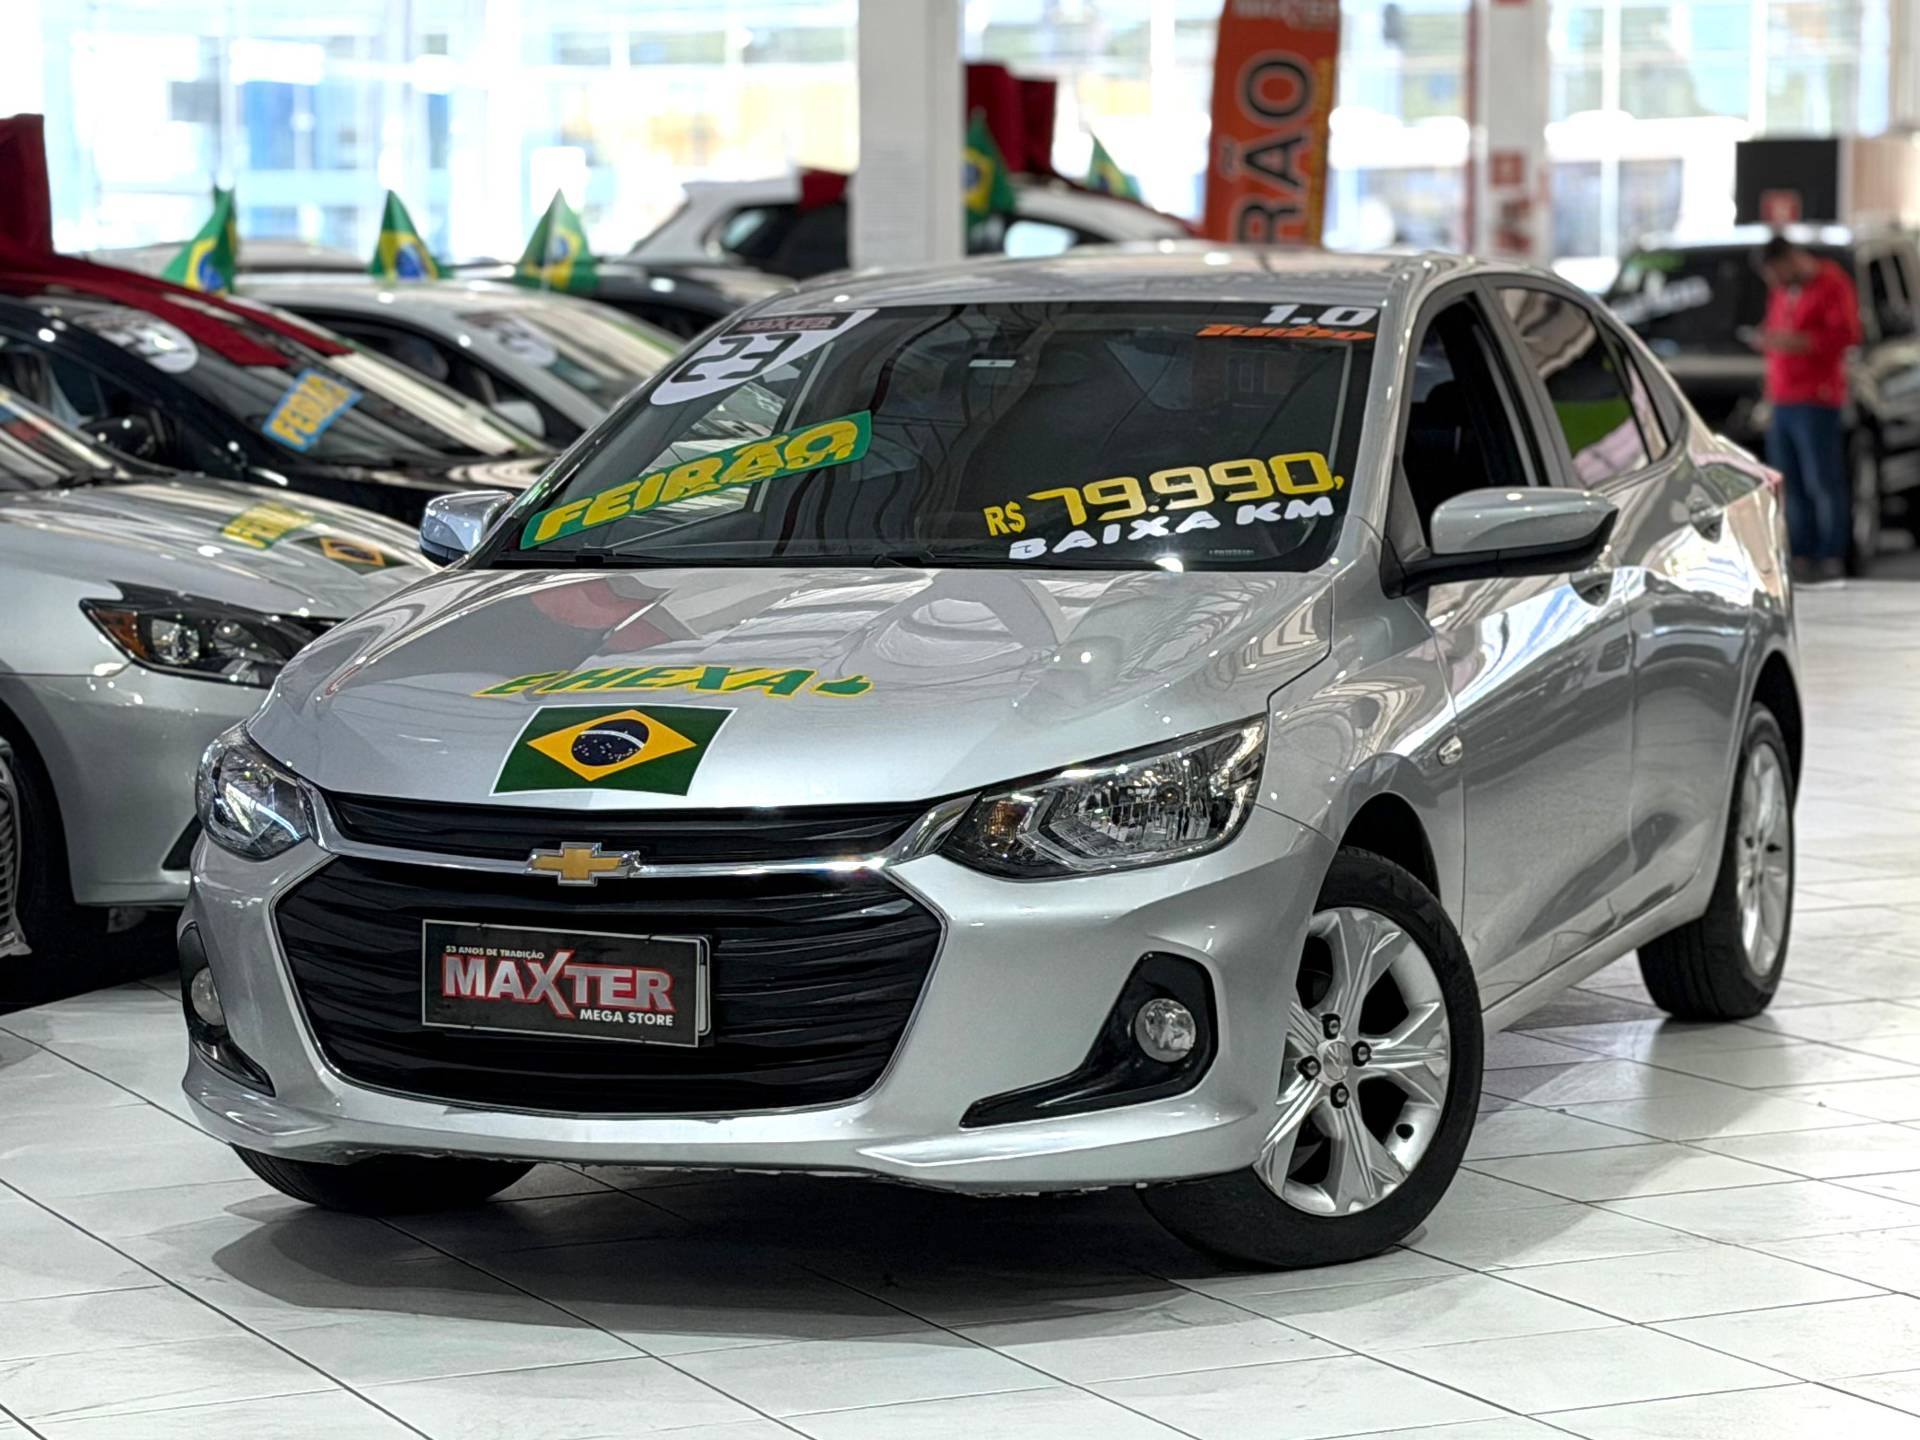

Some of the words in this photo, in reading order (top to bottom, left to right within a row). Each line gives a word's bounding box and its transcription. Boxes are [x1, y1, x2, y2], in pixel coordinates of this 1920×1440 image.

[1261, 304, 1378, 326] 1.0
[670, 333, 802, 383] 23
[534, 420, 858, 541] FEIRÃO
[984, 501, 1027, 536] R$
[1009, 511, 1221, 559] BAIXA
[1236, 497, 1334, 525] KM
[458, 947, 484, 956] ANOS
[485, 948, 498, 957] DE
[499, 949, 545, 960] TRADIÇÃO
[443, 948, 677, 1018] MAXTER
[579, 1008, 624, 1023] MEGA
[627, 1012, 674, 1027] STORE
